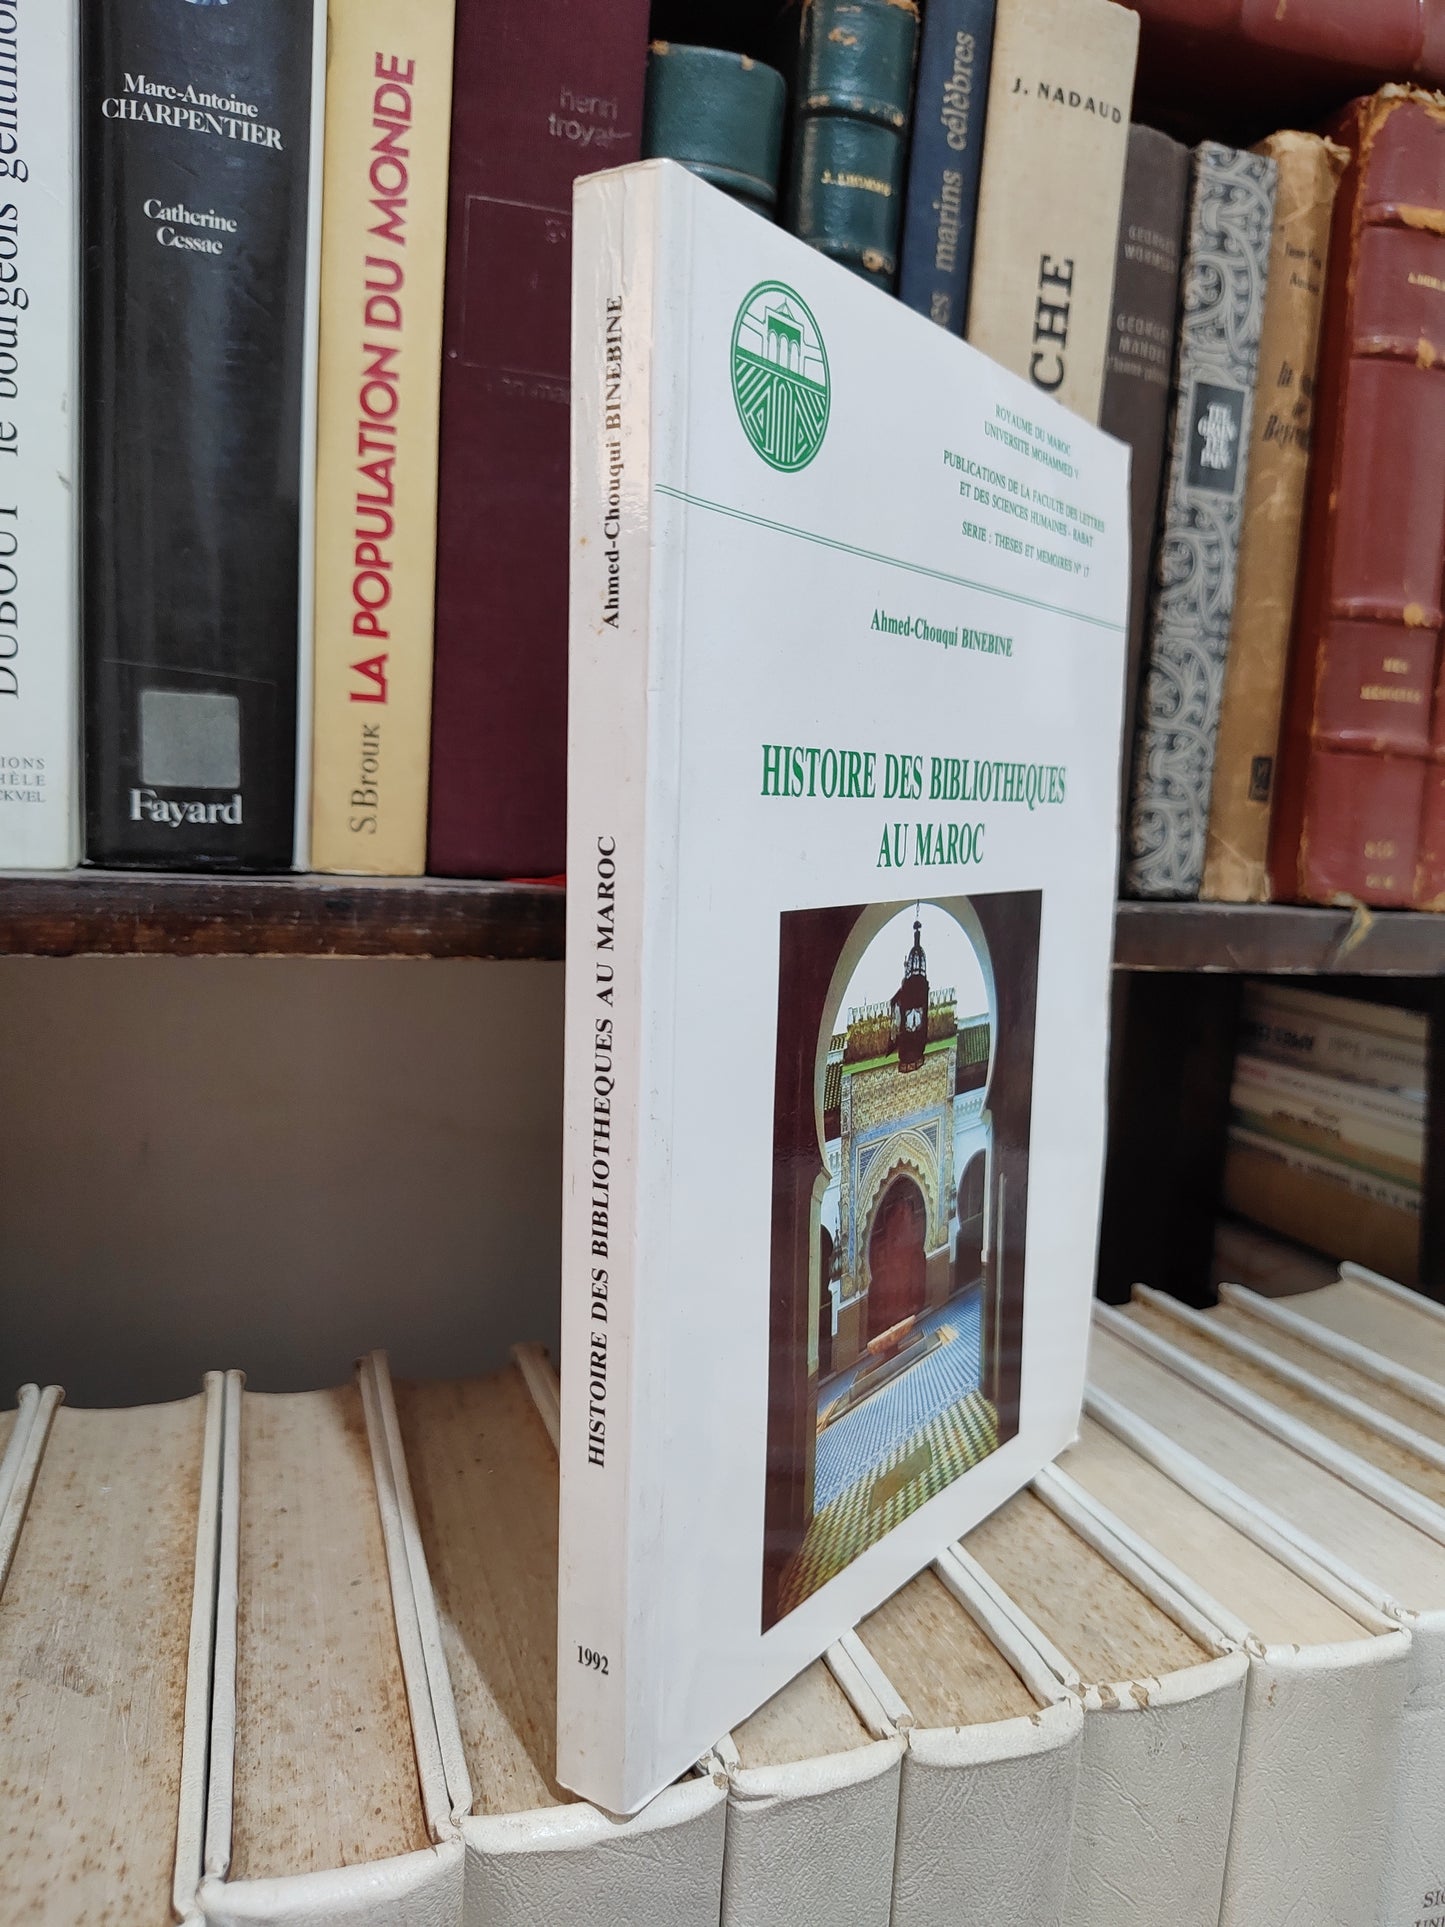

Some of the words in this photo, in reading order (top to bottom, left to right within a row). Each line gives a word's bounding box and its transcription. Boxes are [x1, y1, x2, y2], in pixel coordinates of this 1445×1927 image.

[123, 73, 259, 118] Marc-Antoine
[941, 31, 975, 151] célèbres
[1012, 78, 1028, 94] J.
[1038, 82, 1122, 124] NADAUD
[101, 98, 284, 150] CHARPENTIER
[367, 52, 416, 246] MONDE
[143, 199, 238, 233] Catherine
[156, 226, 223, 255] Cessac
[933, 169, 963, 273] marins
[364, 256, 405, 333] DU
[605, 295, 622, 432] BINEBINE
[984, 421, 1030, 456] UNIVERSITE
[1031, 446, 1073, 478] MOHAMMED
[995, 404, 1033, 436] ROYAUME
[1034, 426, 1046, 442] DU
[352, 343, 401, 640] POPULATION
[943, 450, 1006, 489] PUBLICATIONS
[1008, 478, 1019, 495] DE
[1020, 483, 1030, 500] LA
[1032, 490, 1065, 515] FACULTE
[1066, 501, 1078, 520] DES
[1079, 507, 1105, 533] LETTRES
[960, 481, 971, 498] ET
[973, 487, 990, 506] DES
[991, 494, 1028, 521] SCIENCES
[1030, 510, 1068, 536] HUMAINES
[1072, 528, 1094, 548] RABAT
[603, 440, 624, 630] Ahmed-Chouqui
[961, 521, 987, 543] SERIE
[994, 532, 1023, 555] THESES
[1024, 544, 1035, 559] ET
[1036, 549, 1072, 573] MEMOIRES
[870, 608, 958, 649] Ahmed-Chouqui
[961, 627, 1013, 657] BINEBINE
[349, 653, 390, 705] LA
[760, 744, 877, 799] HISTOIRE
[883, 753, 923, 800] DES
[928, 757, 1067, 811] BIBLIOTHEQUES
[129, 788, 243, 828] Fayard
[876, 822, 909, 868] AU
[913, 823, 985, 866] MAROC
[597, 836, 616, 952] MAROC
[596, 962, 615, 1008] AU
[591, 1018, 615, 1260] BIBLIOTHEQUES
[591, 1267, 609, 1324] DES
[588, 1331, 607, 1468] HISTOIRE
[577, 1645, 609, 1676] 1992
[1422, 1889, 1445, 1909] SI
